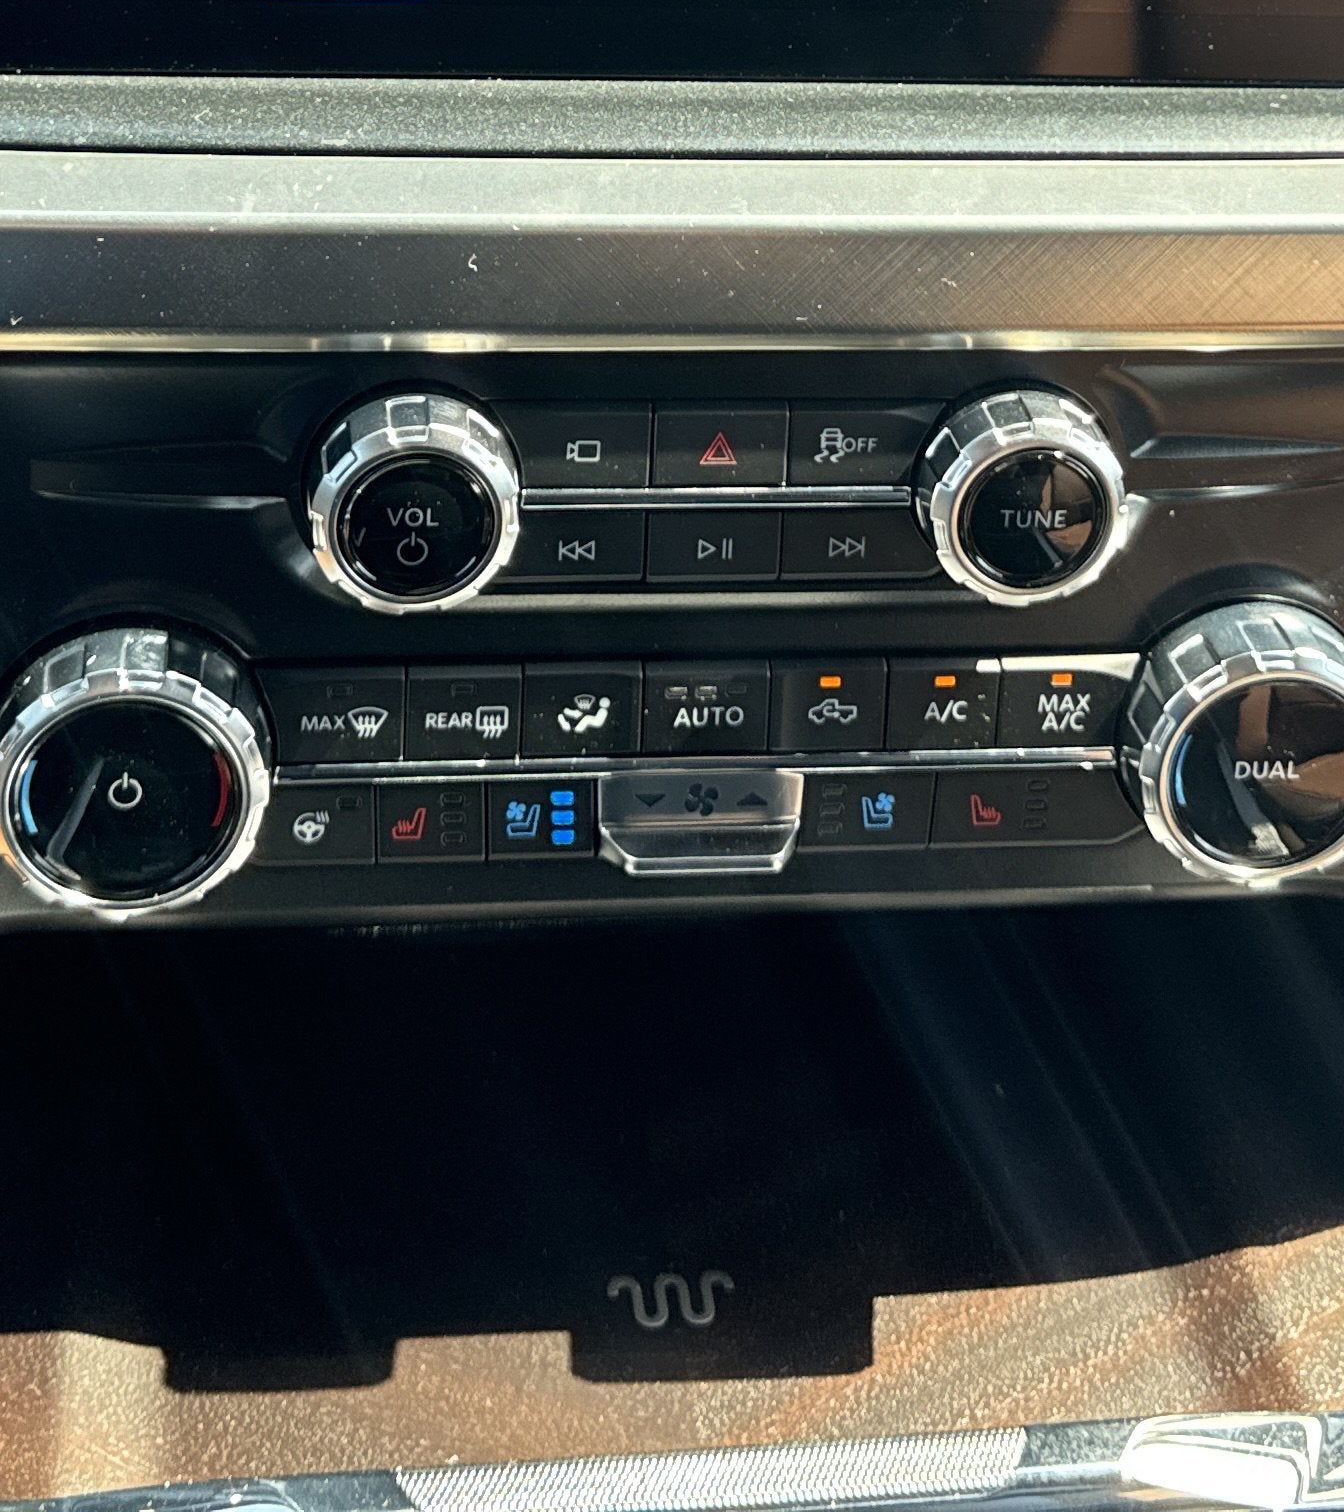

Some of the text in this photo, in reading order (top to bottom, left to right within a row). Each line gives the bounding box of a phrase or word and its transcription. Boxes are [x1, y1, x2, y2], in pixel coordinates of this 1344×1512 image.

[843, 438, 878, 453] OFF
[387, 507, 439, 527] VOL
[1000, 509, 1068, 528] TUNE
[924, 700, 968, 724] A/C
[1038, 694, 1091, 714] MAX
[300, 715, 345, 732] MAX
[425, 711, 472, 728] REAR
[673, 706, 744, 728] AUTO
[1041, 711, 1086, 732] A/C
[1234, 760, 1300, 780] DUAL
